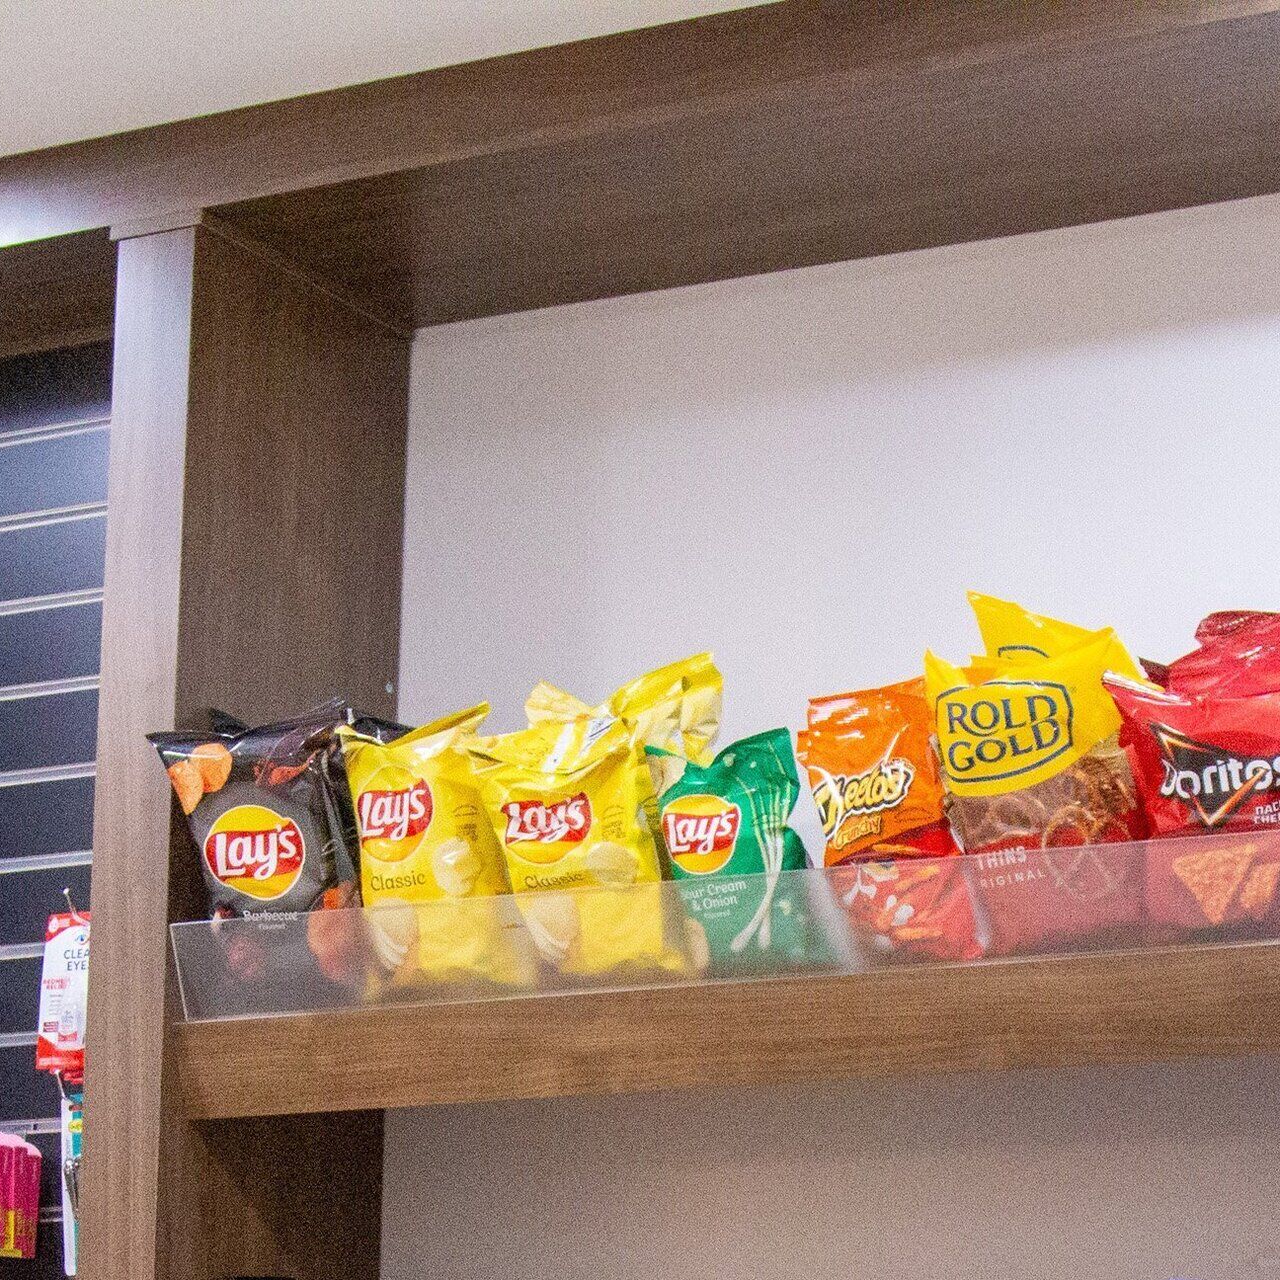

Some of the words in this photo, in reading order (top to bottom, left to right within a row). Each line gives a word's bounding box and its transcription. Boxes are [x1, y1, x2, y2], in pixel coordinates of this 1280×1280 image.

[946, 695, 1059, 736] ROLD
[947, 720, 1061, 773] GOLD
[360, 781, 427, 842] Lay's
[506, 794, 586, 844] Lay's
[669, 809, 738, 855] Lay's
[216, 823, 297, 880] Lay's
[977, 845, 1028, 869] THINS
[370, 870, 426, 891] Classic
[524, 872, 584, 889] Classic
[708, 879, 747, 896] Cream
[703, 895, 738, 911] Onion
